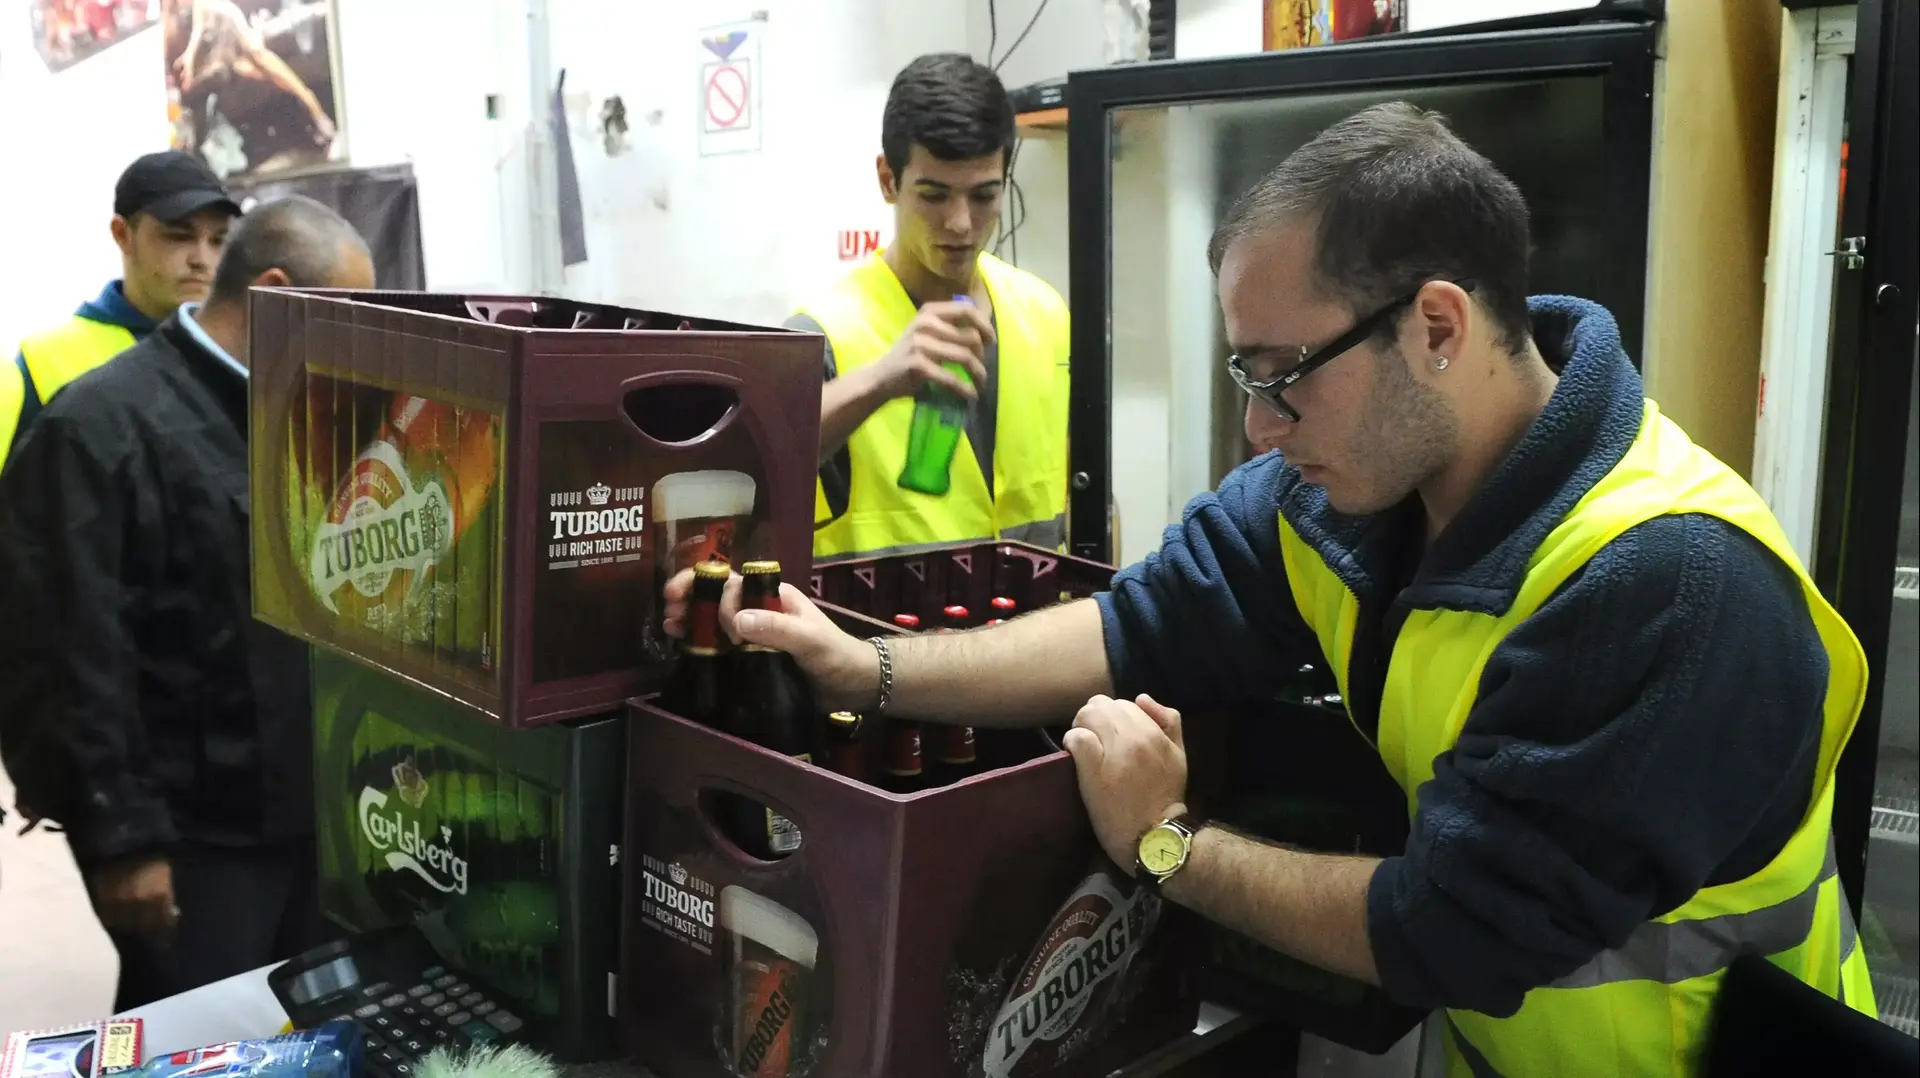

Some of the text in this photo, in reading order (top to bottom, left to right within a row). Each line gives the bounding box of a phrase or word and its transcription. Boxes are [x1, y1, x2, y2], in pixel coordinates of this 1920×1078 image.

[319, 508, 420, 579] TUBORG
[550, 505, 644, 539] TUBORG
[570, 537, 623, 557] RICH TASTE
[358, 785, 468, 895] Carlsberg
[642, 870, 714, 928] TUBORG
[655, 907, 673, 926] RICH
[674, 915, 697, 938] TASTE
[997, 917, 1127, 1061] TUBORG
